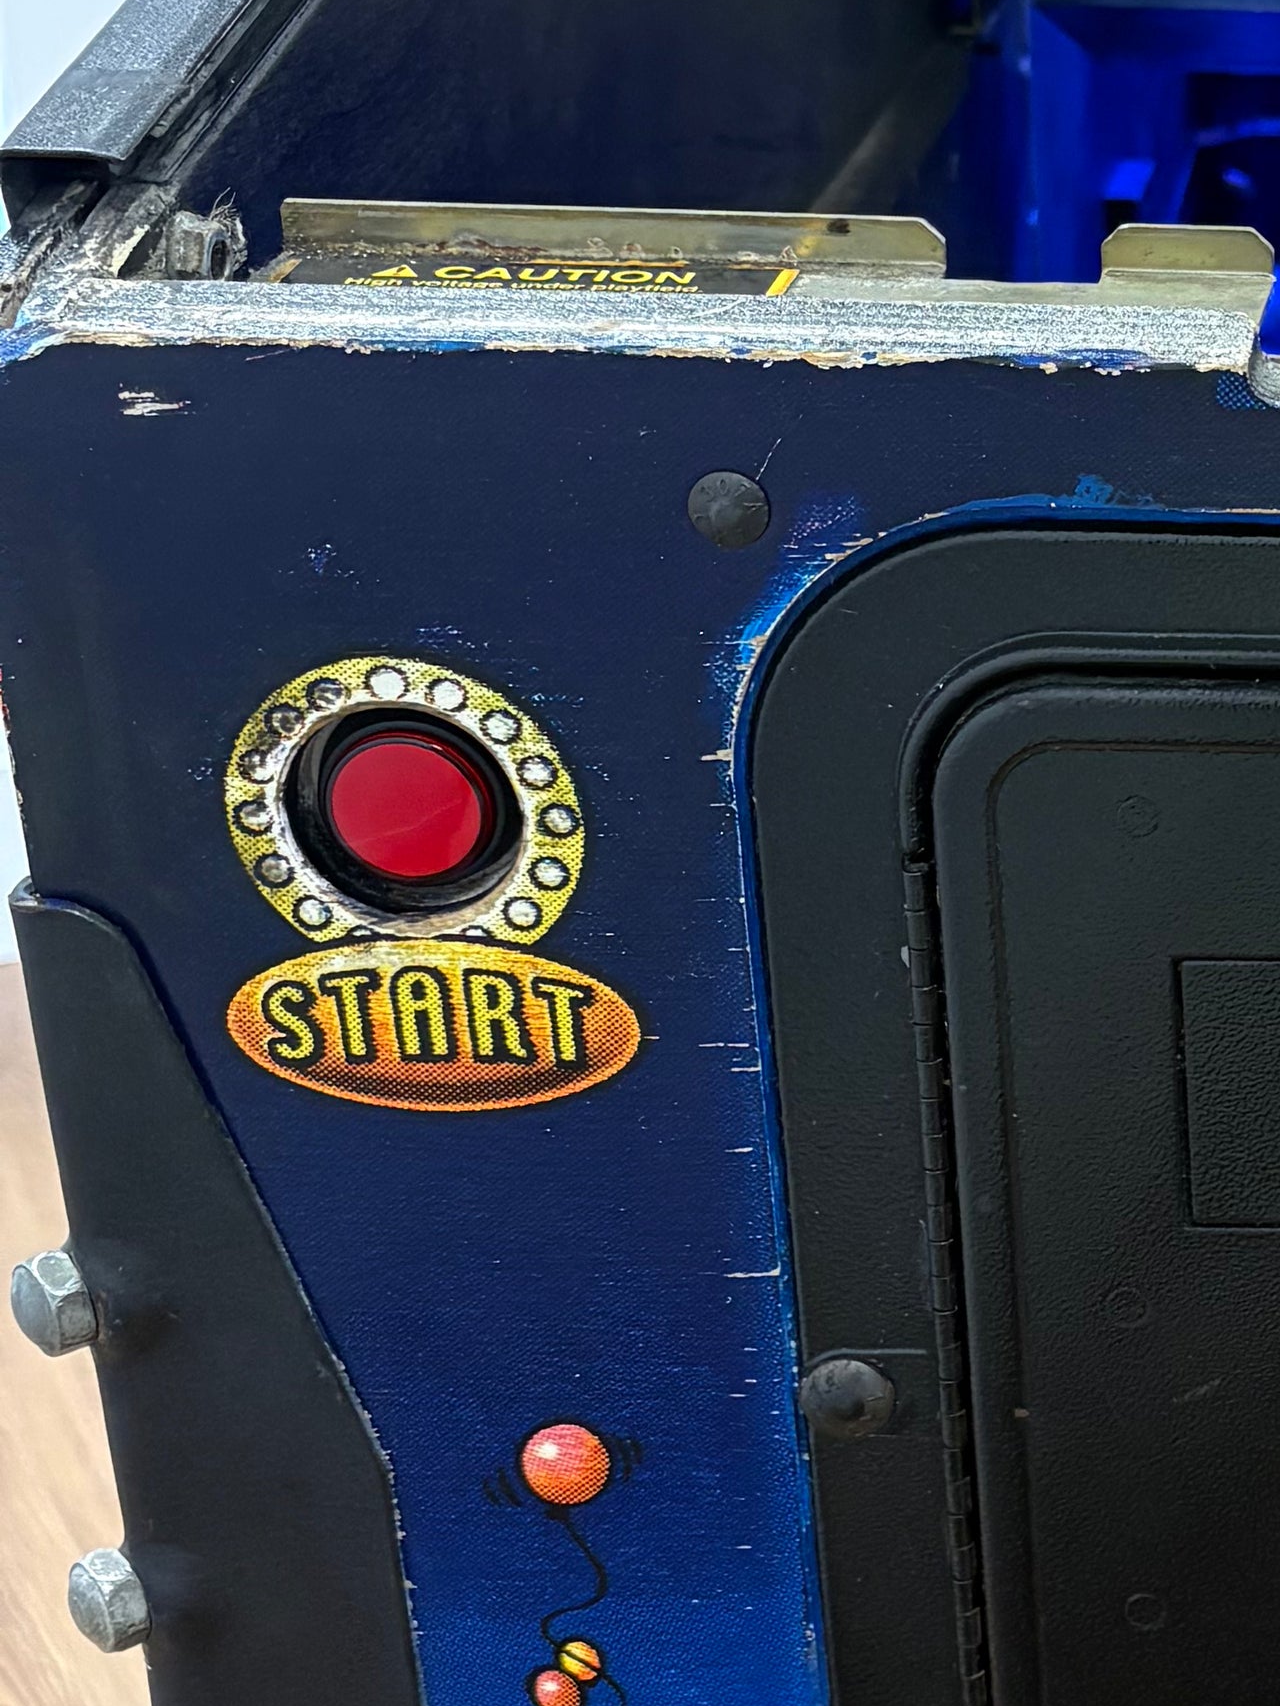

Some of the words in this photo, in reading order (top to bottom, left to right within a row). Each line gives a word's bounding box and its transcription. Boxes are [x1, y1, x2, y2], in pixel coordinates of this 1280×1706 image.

[344, 277, 403, 287] High
[410, 280, 504, 289] voltage
[510, 282, 586, 290] under
[434, 265, 697, 284] CAUTION
[260, 966, 592, 1068] START
